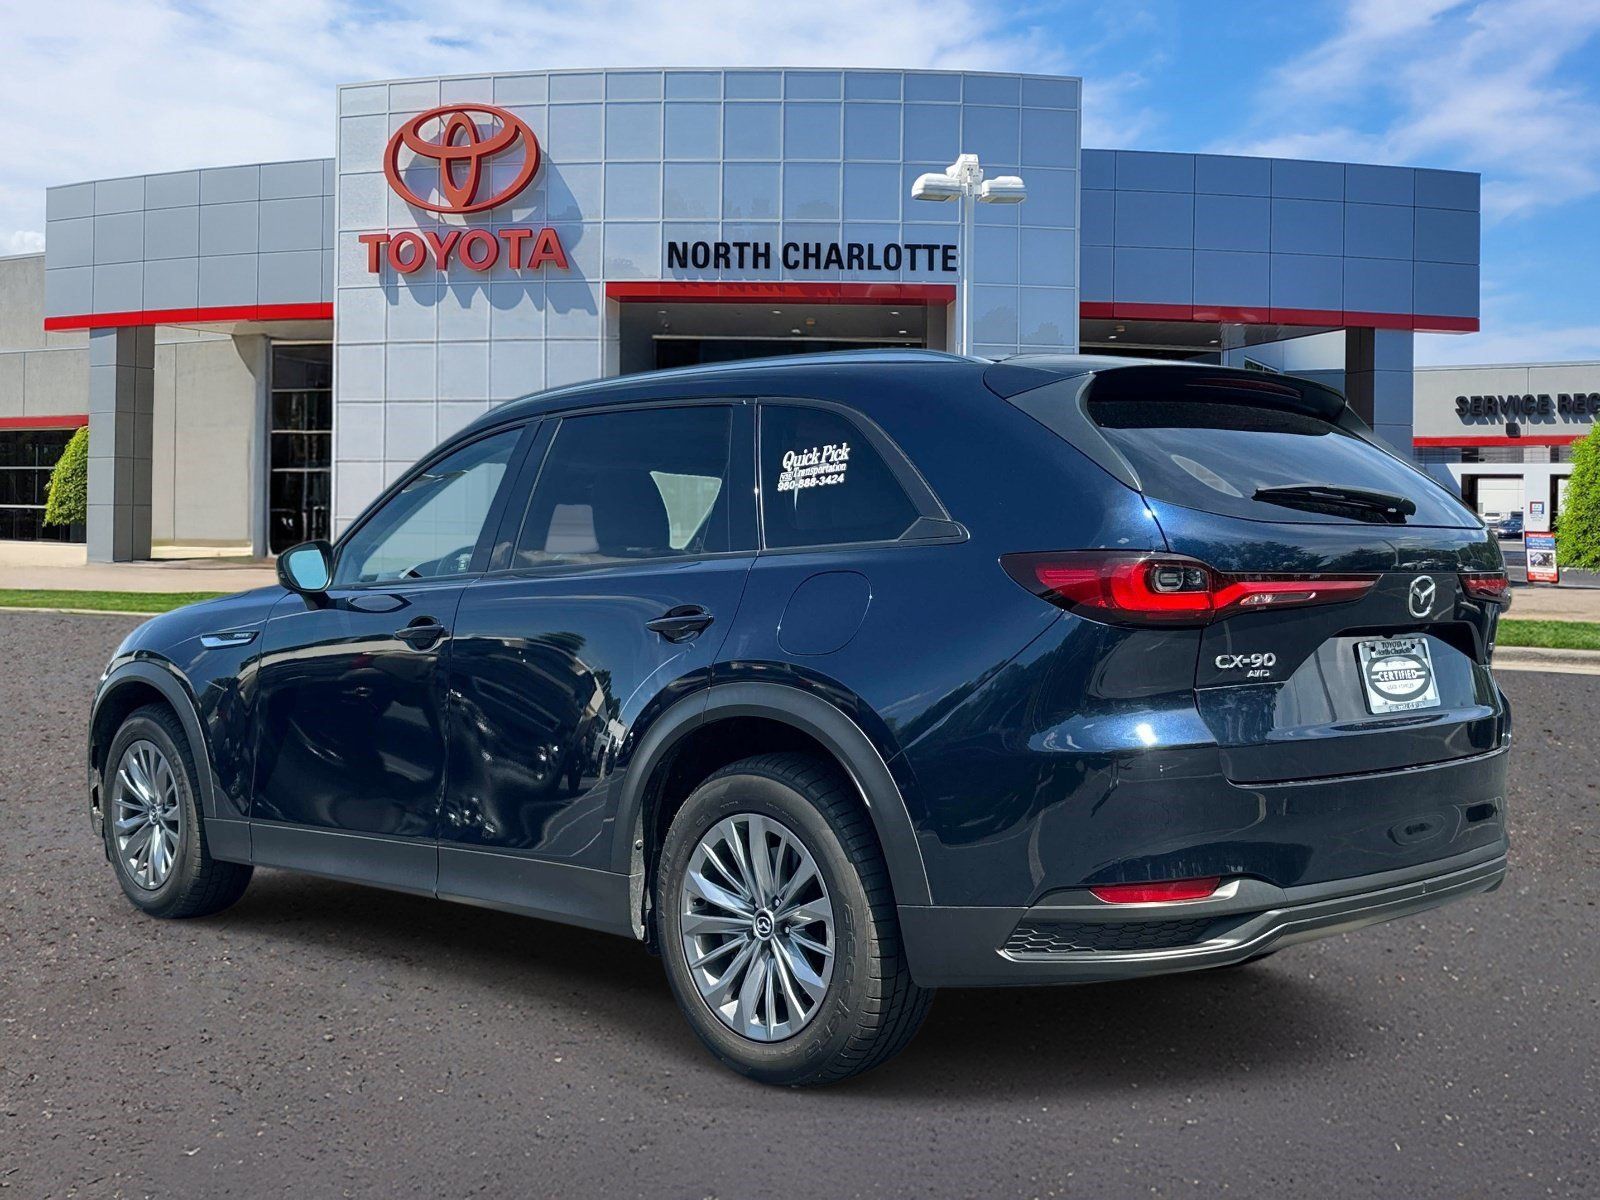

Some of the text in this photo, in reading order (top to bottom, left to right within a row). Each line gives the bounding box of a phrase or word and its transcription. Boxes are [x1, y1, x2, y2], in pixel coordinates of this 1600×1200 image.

[358, 228, 569, 274] TOYOTA
[667, 241, 958, 272] NORTH CHARLOTTE
[1455, 394, 1551, 417] SERVICE
[783, 442, 850, 471] Quick Pick
[793, 461, 847, 478] Transportation
[1381, 641, 1403, 649] TOYOTA
[1215, 652, 1277, 669] CX-90
[1246, 669, 1271, 678] AWD
[1379, 669, 1418, 682] CERTIFIED
